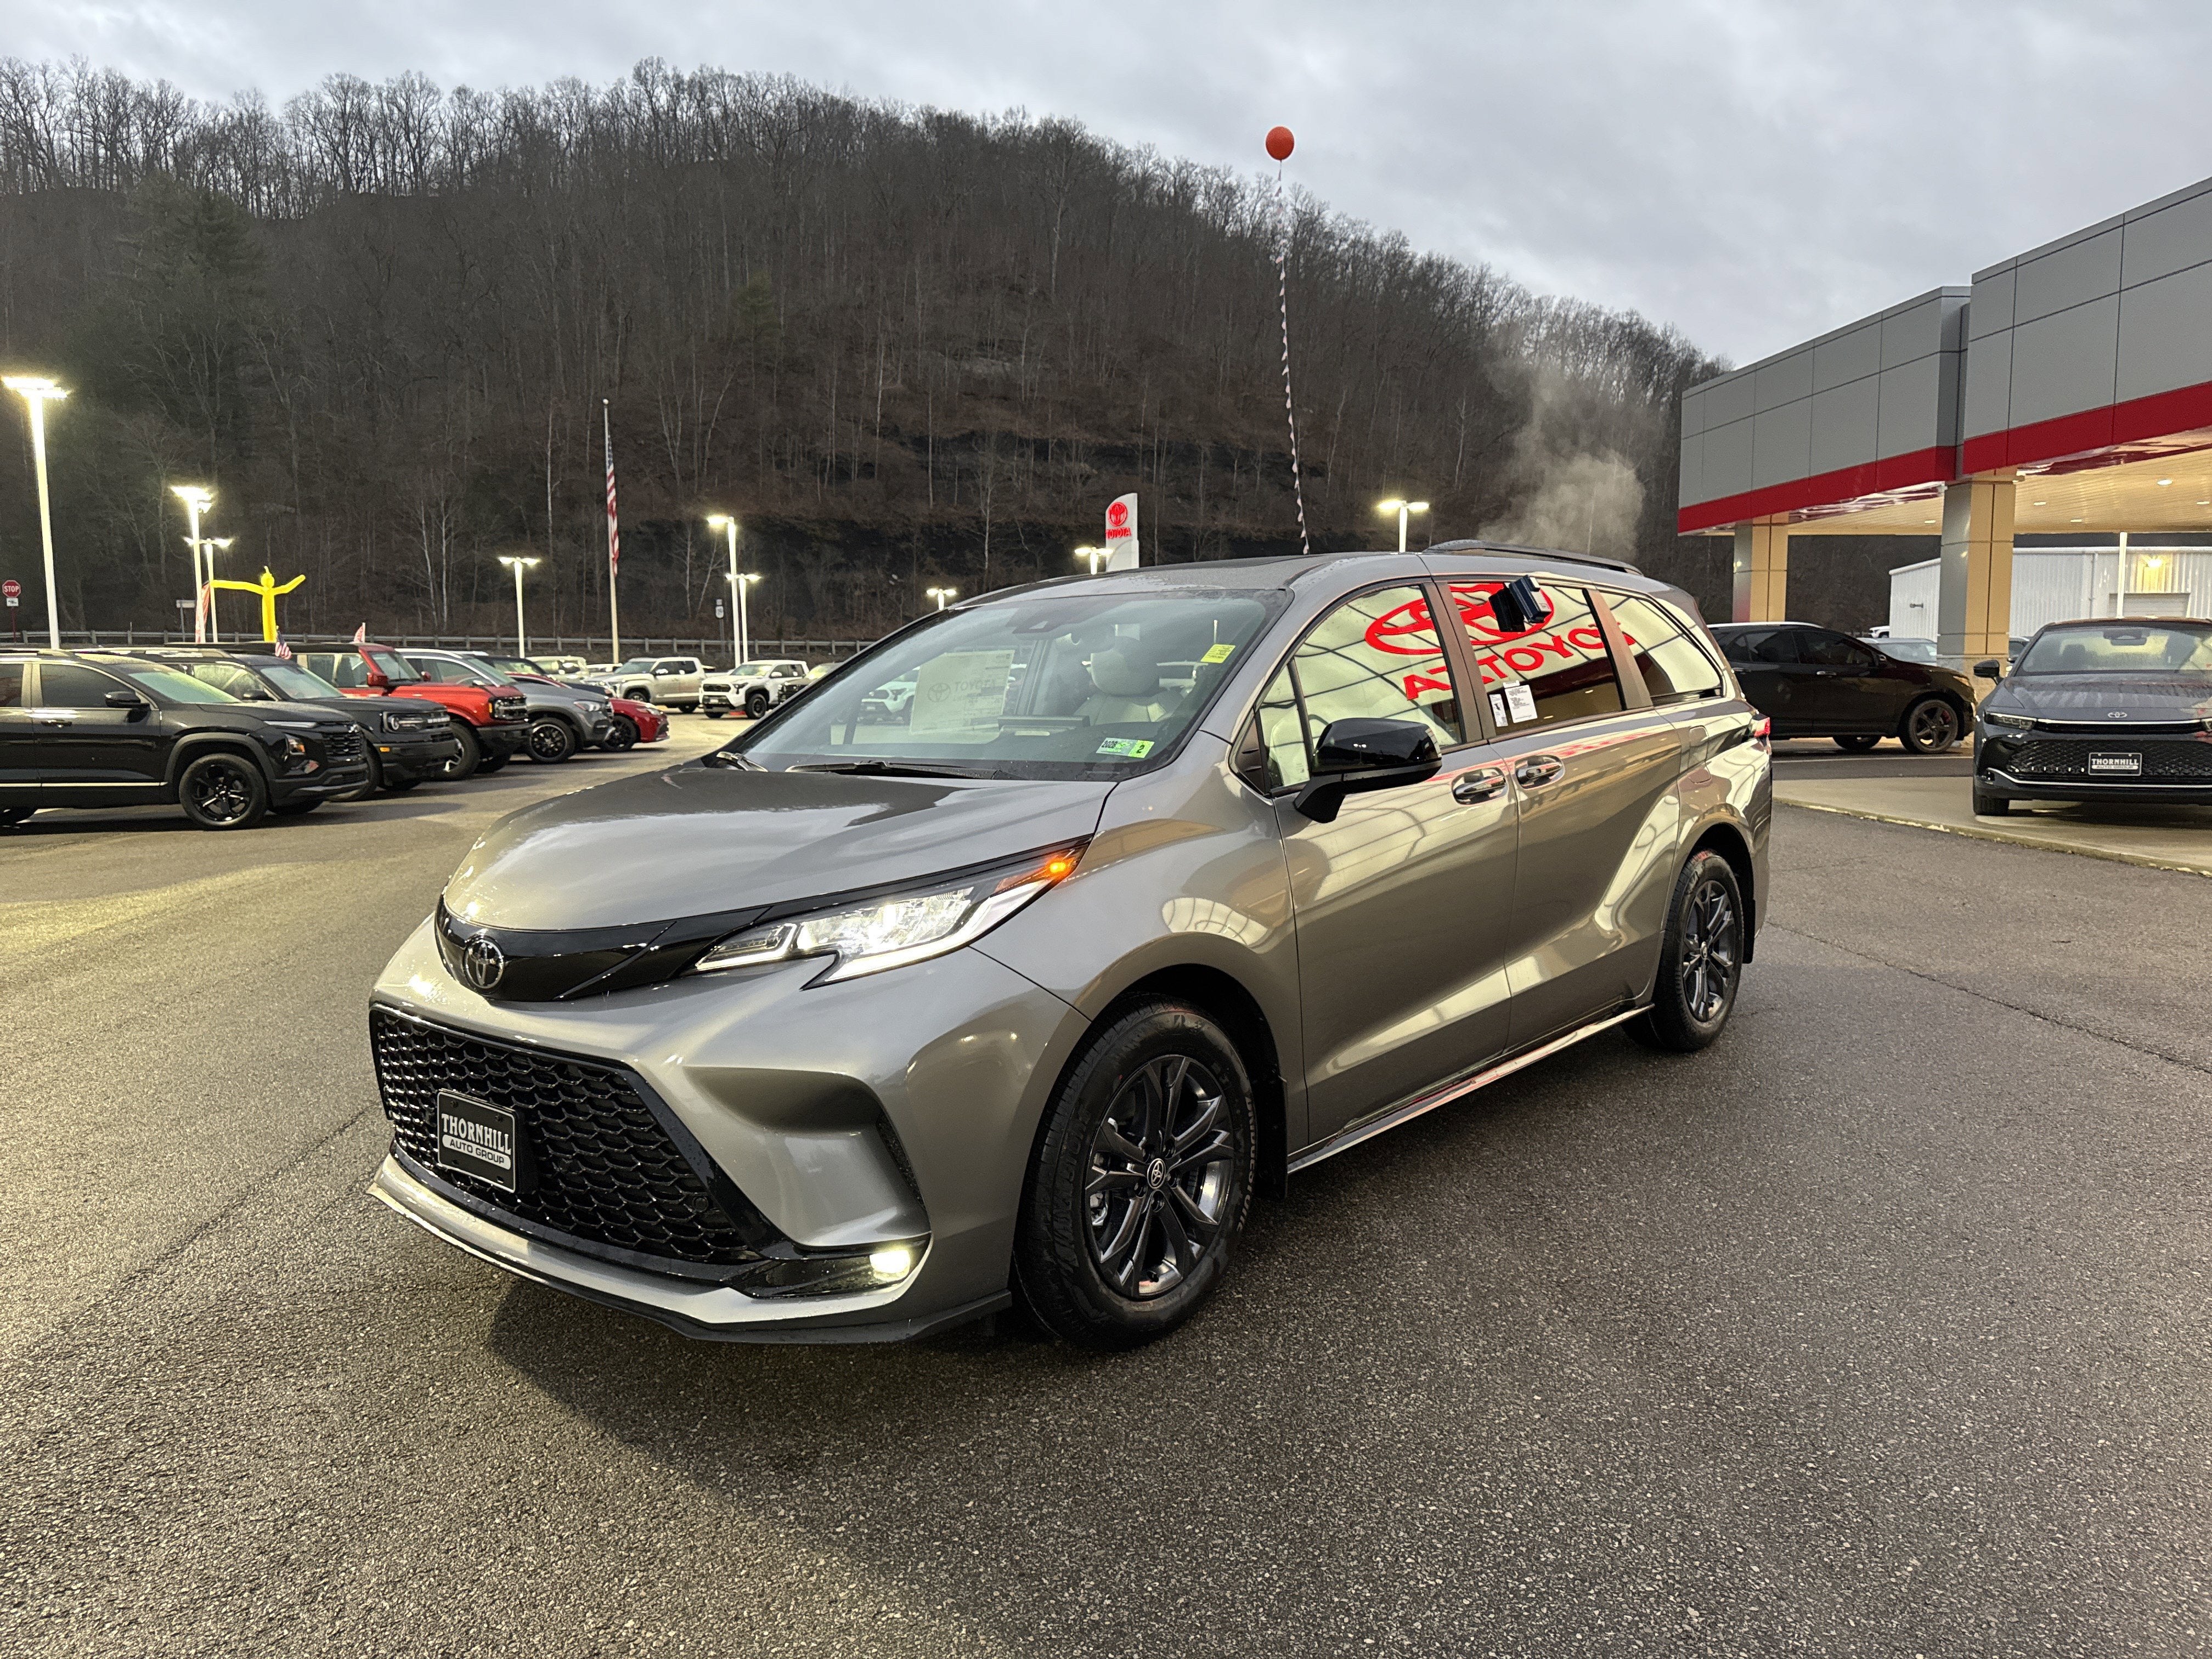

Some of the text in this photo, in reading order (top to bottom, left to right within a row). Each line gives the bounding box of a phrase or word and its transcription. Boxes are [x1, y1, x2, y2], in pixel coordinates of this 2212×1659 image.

[1105, 527, 1132, 540] TOYOTA
[1136, 744, 1146, 754] 2
[441, 1113, 511, 1155] THORNHILL
[449, 1138, 504, 1164] AUTO GROUP
